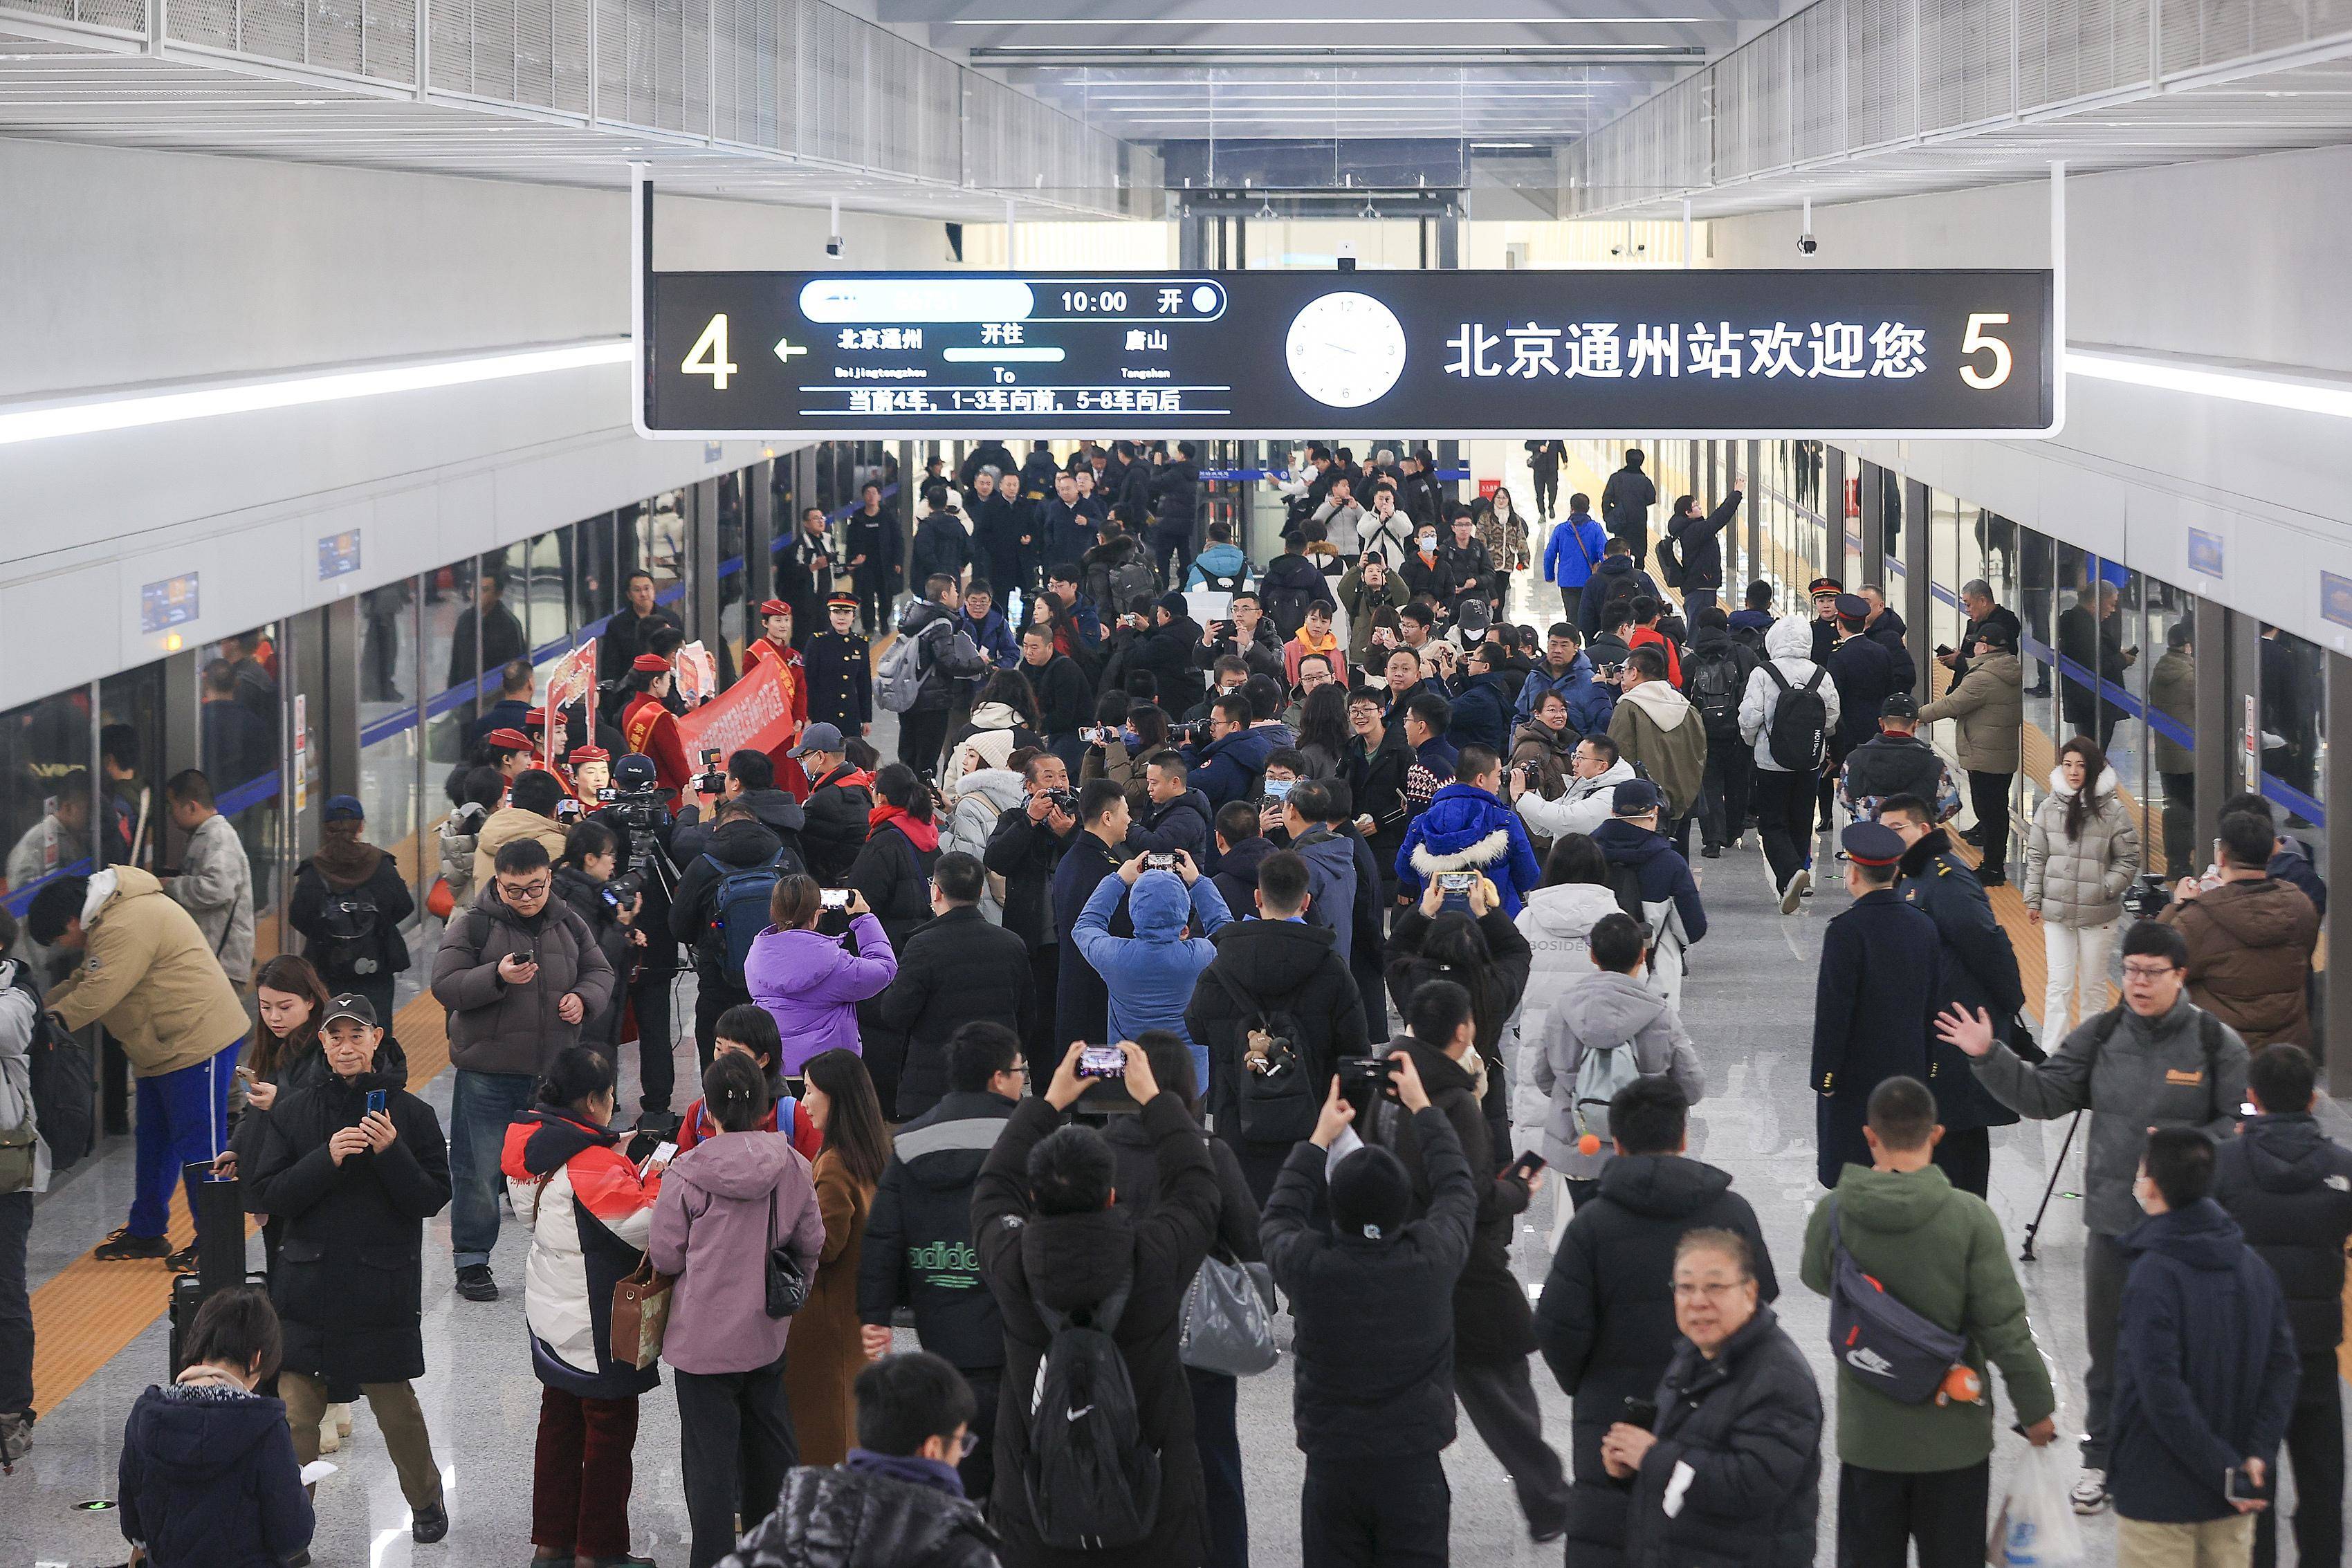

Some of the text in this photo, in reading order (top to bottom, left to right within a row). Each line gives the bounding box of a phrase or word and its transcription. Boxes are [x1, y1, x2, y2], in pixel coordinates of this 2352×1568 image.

[1061, 288, 1184, 314] 10:00 开
[1341, 301, 1354, 311] 12
[837, 328, 923, 349] 北京通州
[980, 323, 1025, 344] 开往
[1124, 329, 1168, 351] 唐山
[681, 313, 737, 390] 4
[1296, 345, 1303, 356] 9
[1388, 345, 1395, 356] 3
[1444, 321, 1927, 379] 北京通州站欢迎您
[1959, 313, 2012, 389] 5
[993, 367, 1016, 384] To
[1121, 367, 1170, 380] Tangshan
[1342, 389, 1349, 398] 6
[1529, 941, 1588, 952] BOSIDE
